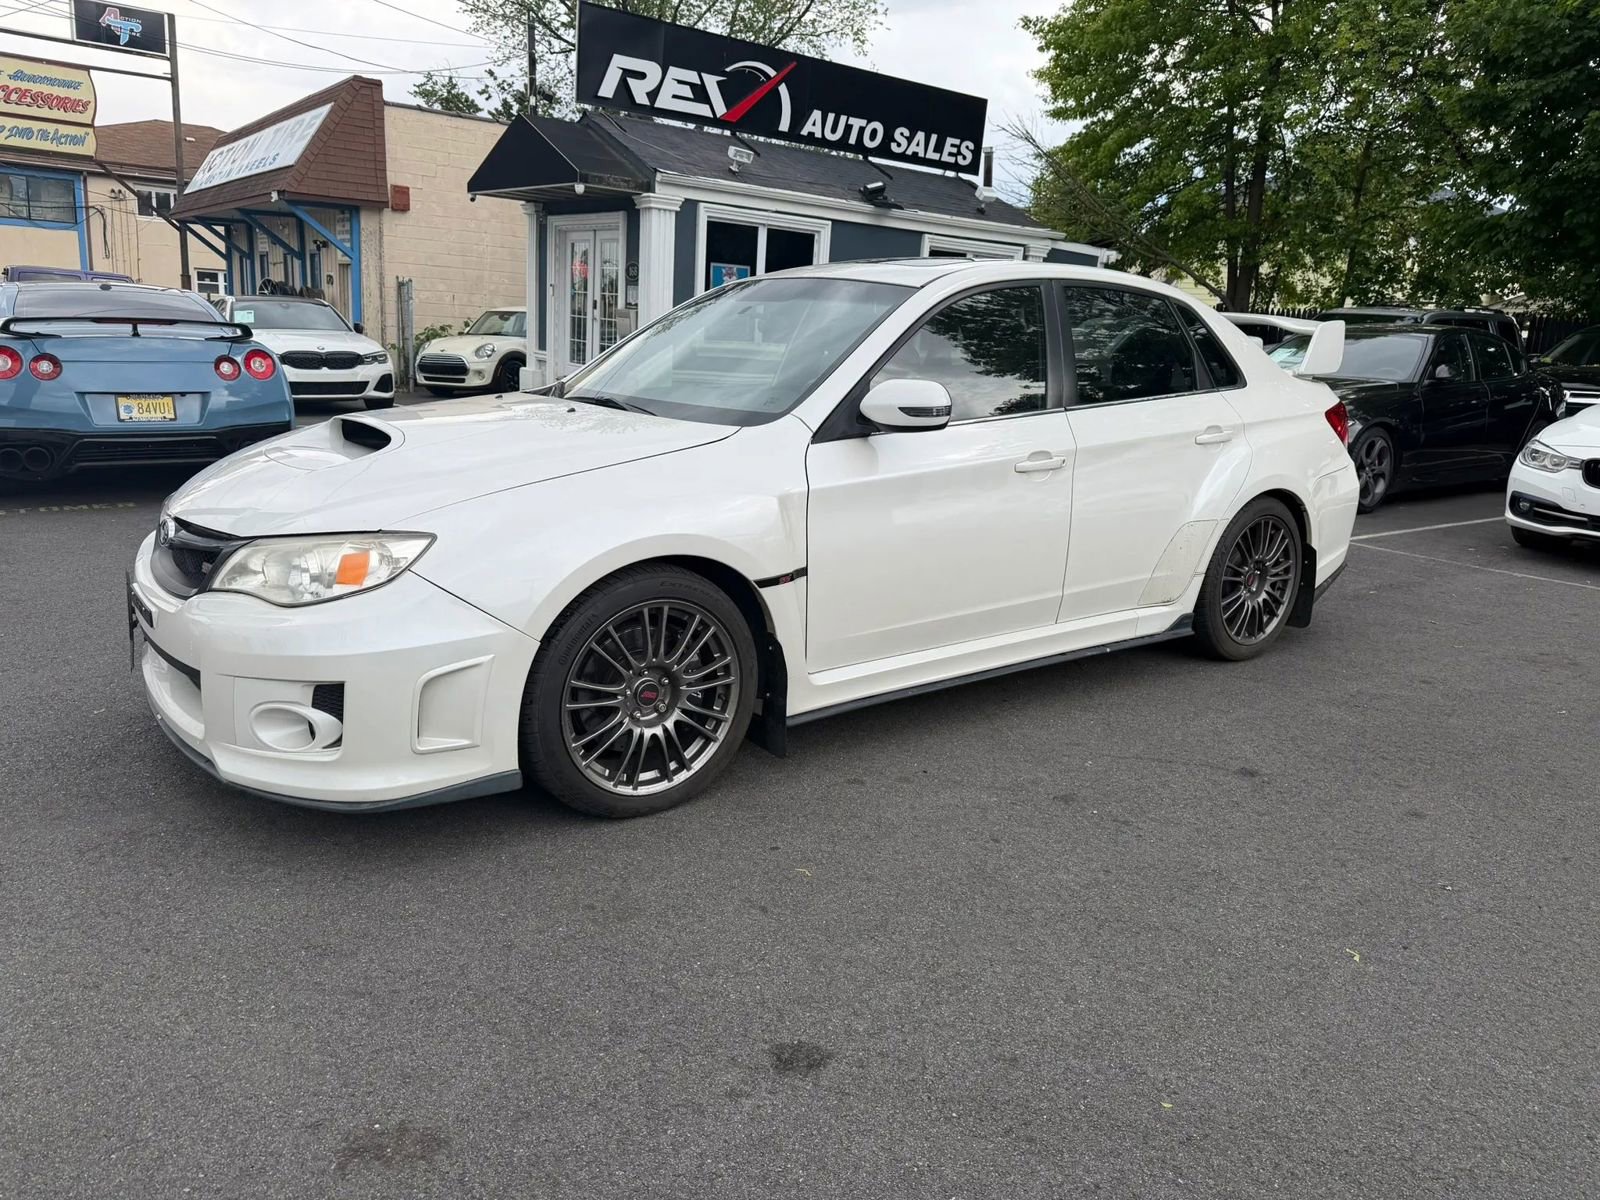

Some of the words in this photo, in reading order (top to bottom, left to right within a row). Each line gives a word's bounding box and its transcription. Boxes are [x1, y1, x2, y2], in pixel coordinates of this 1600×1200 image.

[7, 69, 84, 90] AUTOMOTIVE
[5, 125, 34, 140] INTO
[36, 128, 51, 142] THE
[196, 134, 263, 175] ACTION
[262, 111, 323, 153] TIRE
[801, 109, 884, 149] AUTO
[891, 126, 975, 167] SALES
